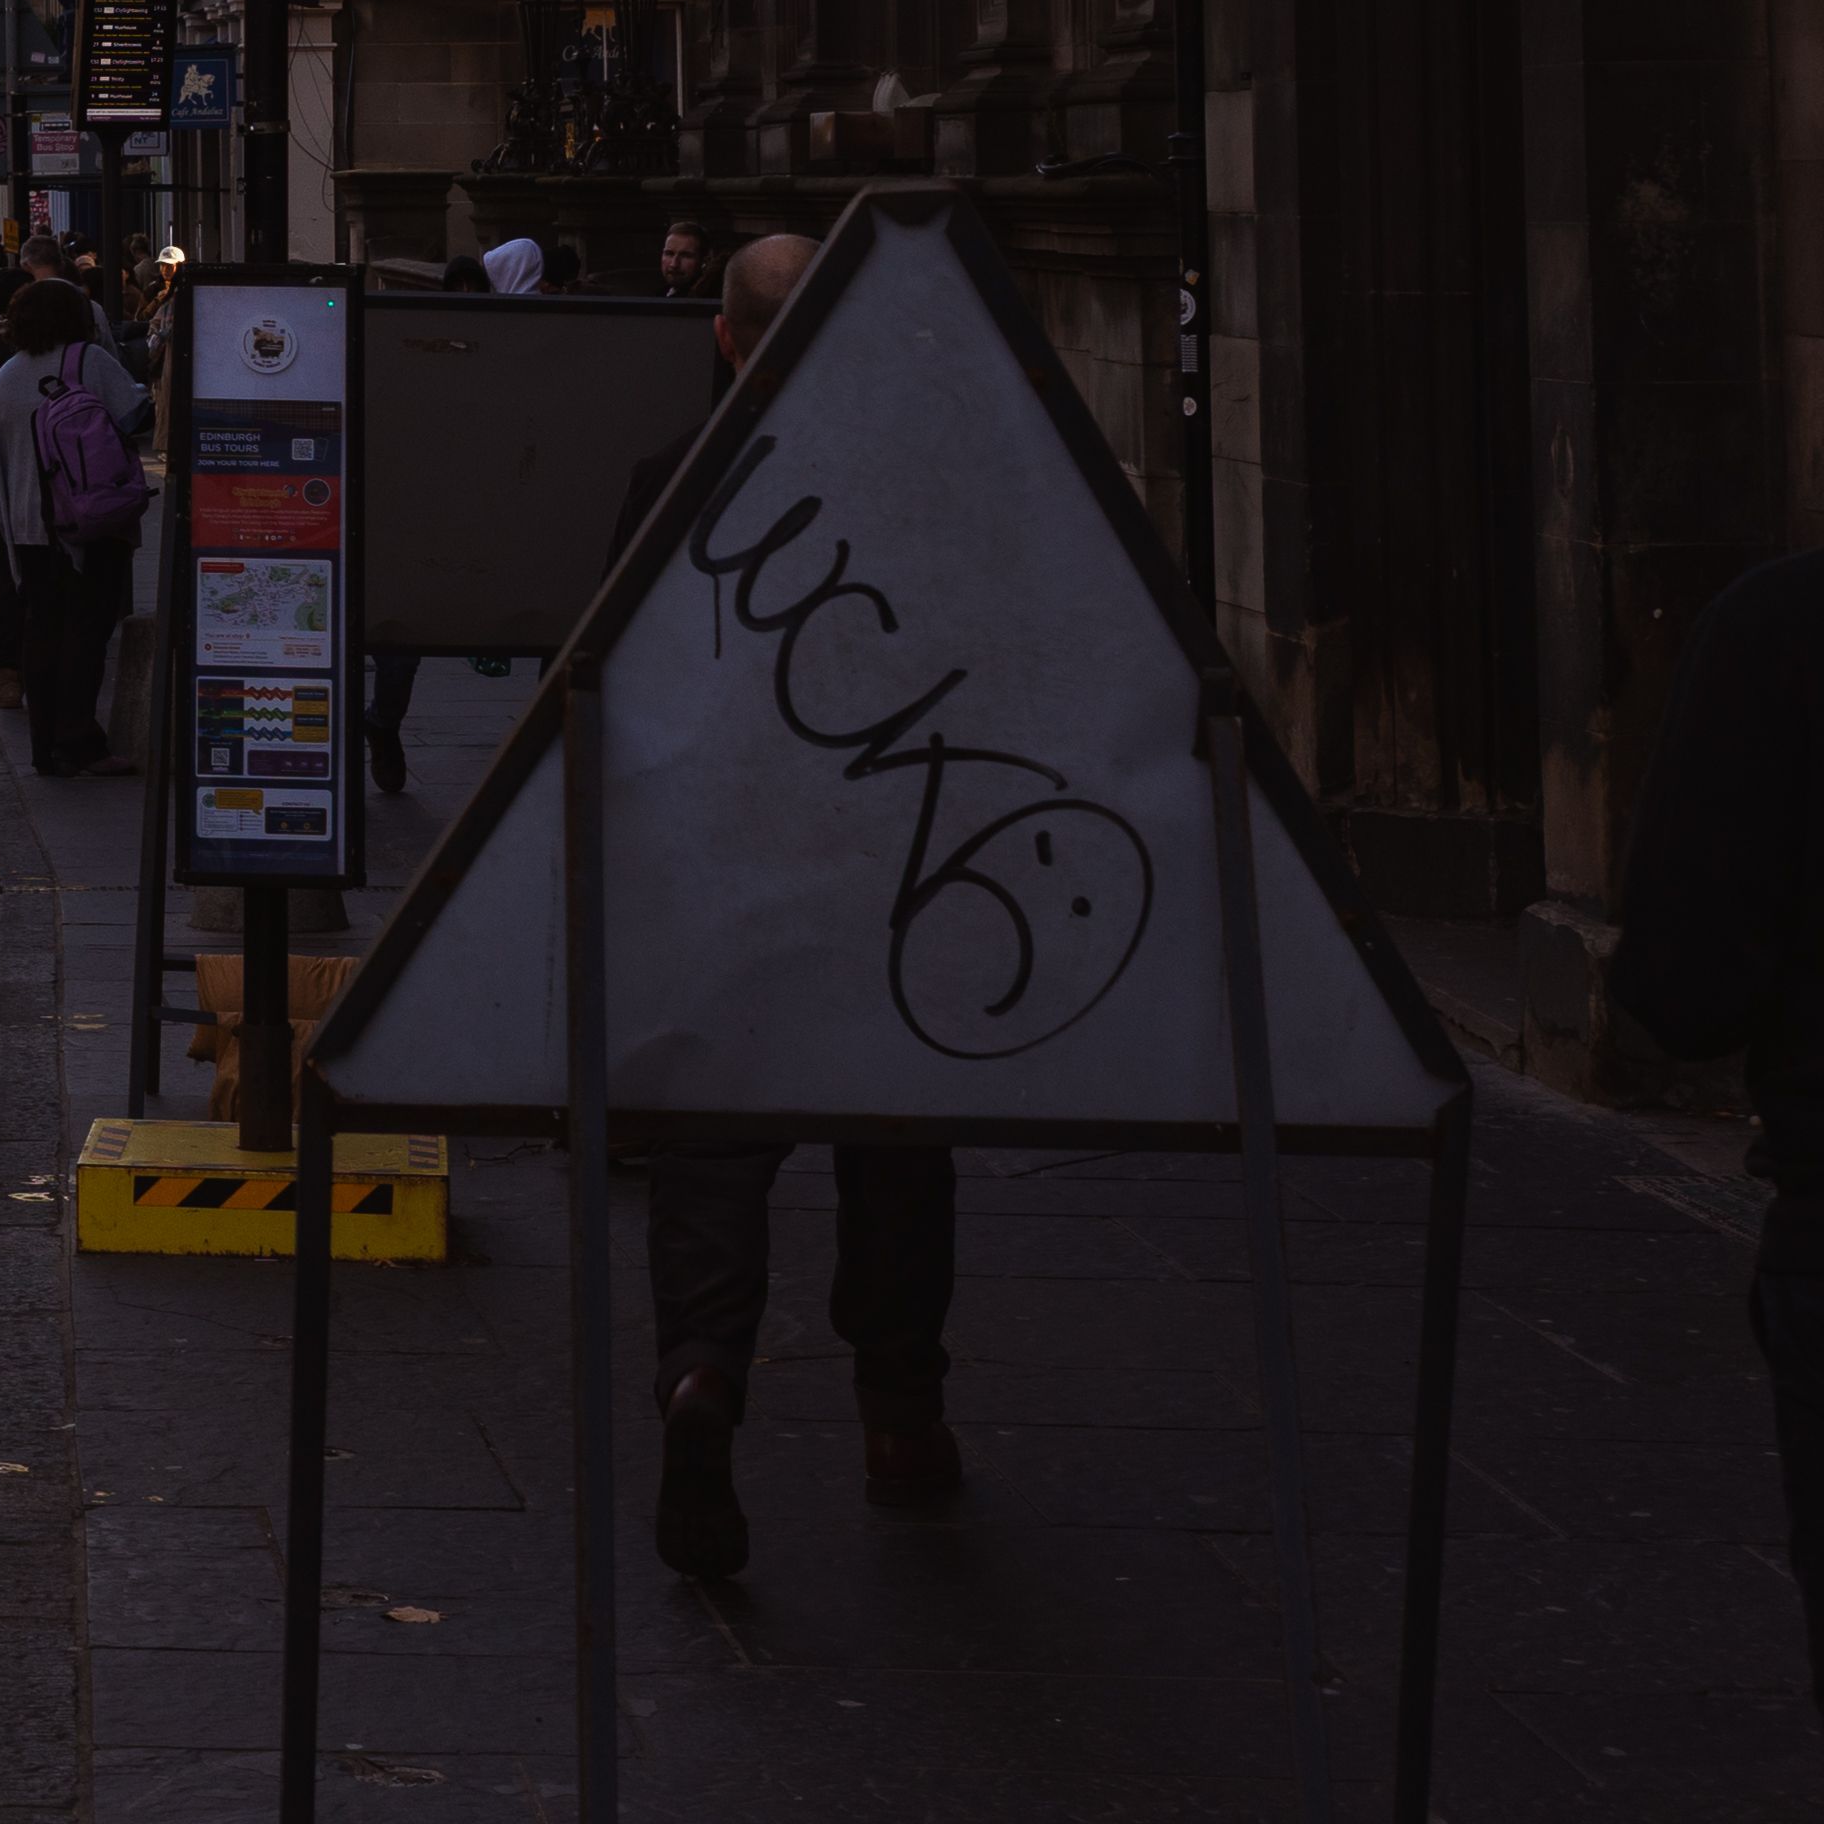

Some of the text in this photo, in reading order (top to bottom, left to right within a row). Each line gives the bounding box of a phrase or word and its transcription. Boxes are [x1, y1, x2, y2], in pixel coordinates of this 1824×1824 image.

[33, 134, 77, 144] Temporary
[54, 143, 74, 152] Stop
[199, 432, 261, 442] EDINBURGH
[200, 443, 260, 453] BUS TOURS
[197, 459, 215, 467] JOIN
[216, 459, 237, 467] YOUR
[260, 460, 280, 468] HERE
